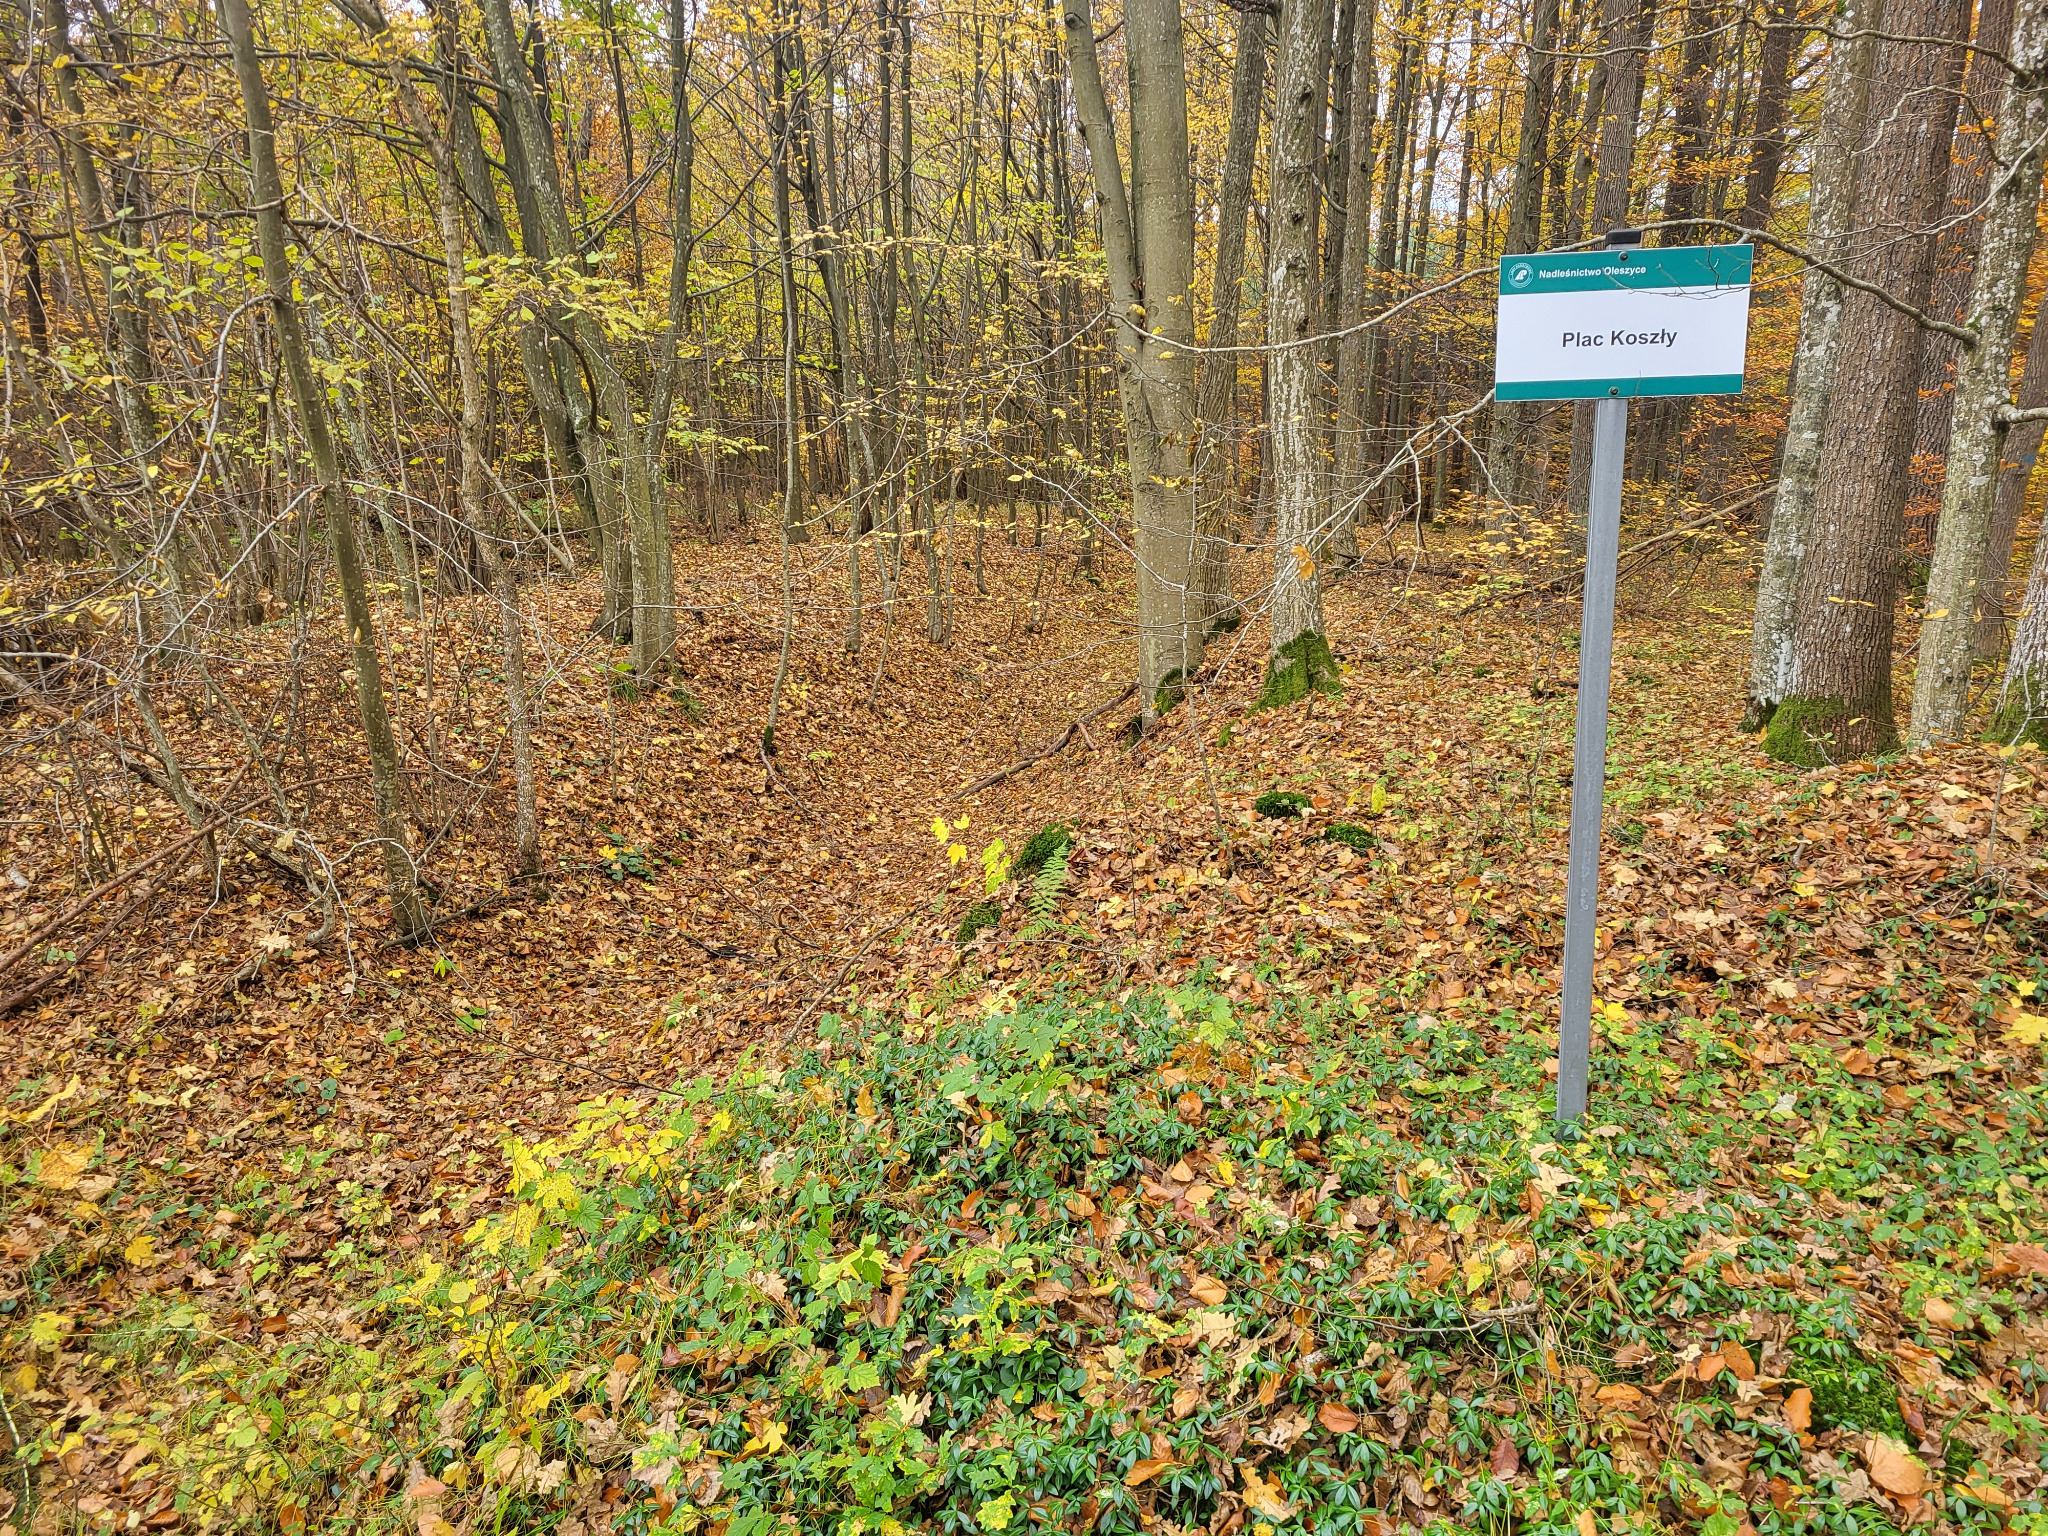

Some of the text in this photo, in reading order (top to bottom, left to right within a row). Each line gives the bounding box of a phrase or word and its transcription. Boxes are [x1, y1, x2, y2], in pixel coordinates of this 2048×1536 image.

[1539, 266, 1647, 279] Nadleśnictwo Oleszyce
[1562, 328, 1678, 348] Plac Koszły
